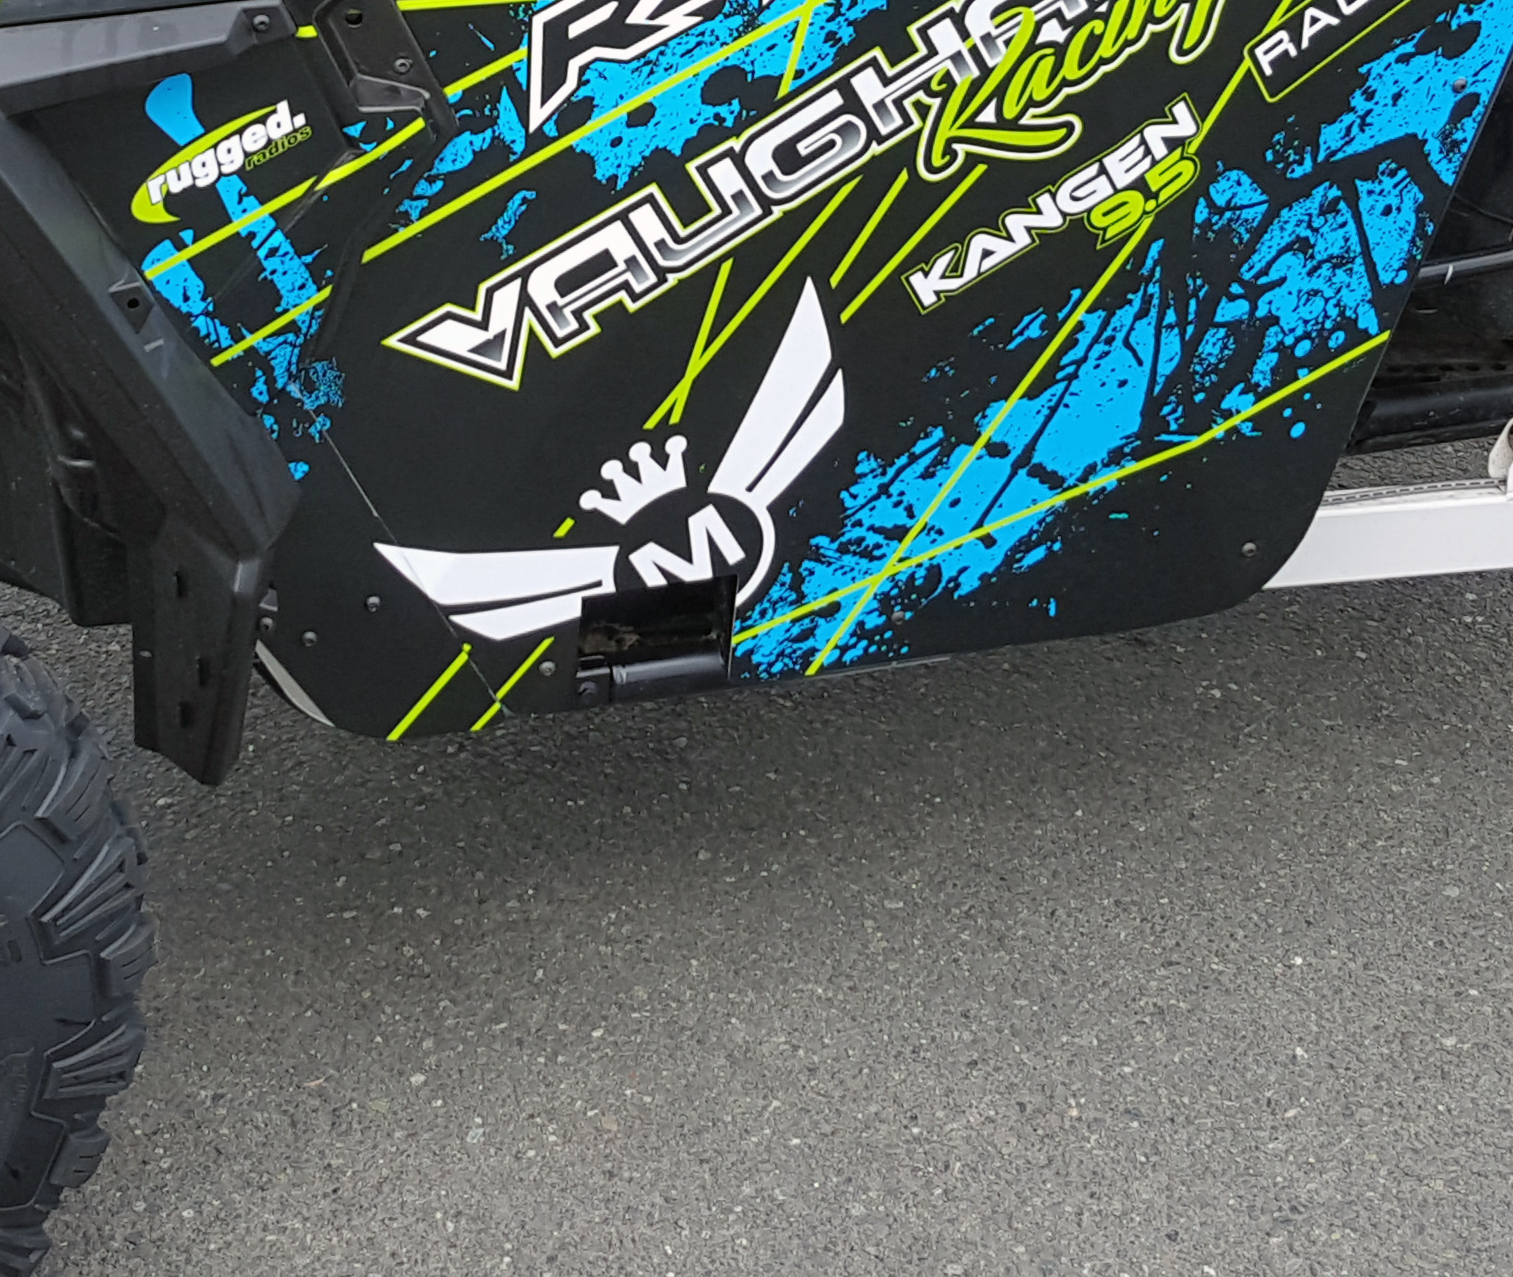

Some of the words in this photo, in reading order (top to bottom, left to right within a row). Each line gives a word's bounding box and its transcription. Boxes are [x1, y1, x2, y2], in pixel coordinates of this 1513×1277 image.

[245, 126, 313, 171] radios
[1089, 146, 1197, 240] 9.5
[907, 99, 1198, 309] KANGEN
